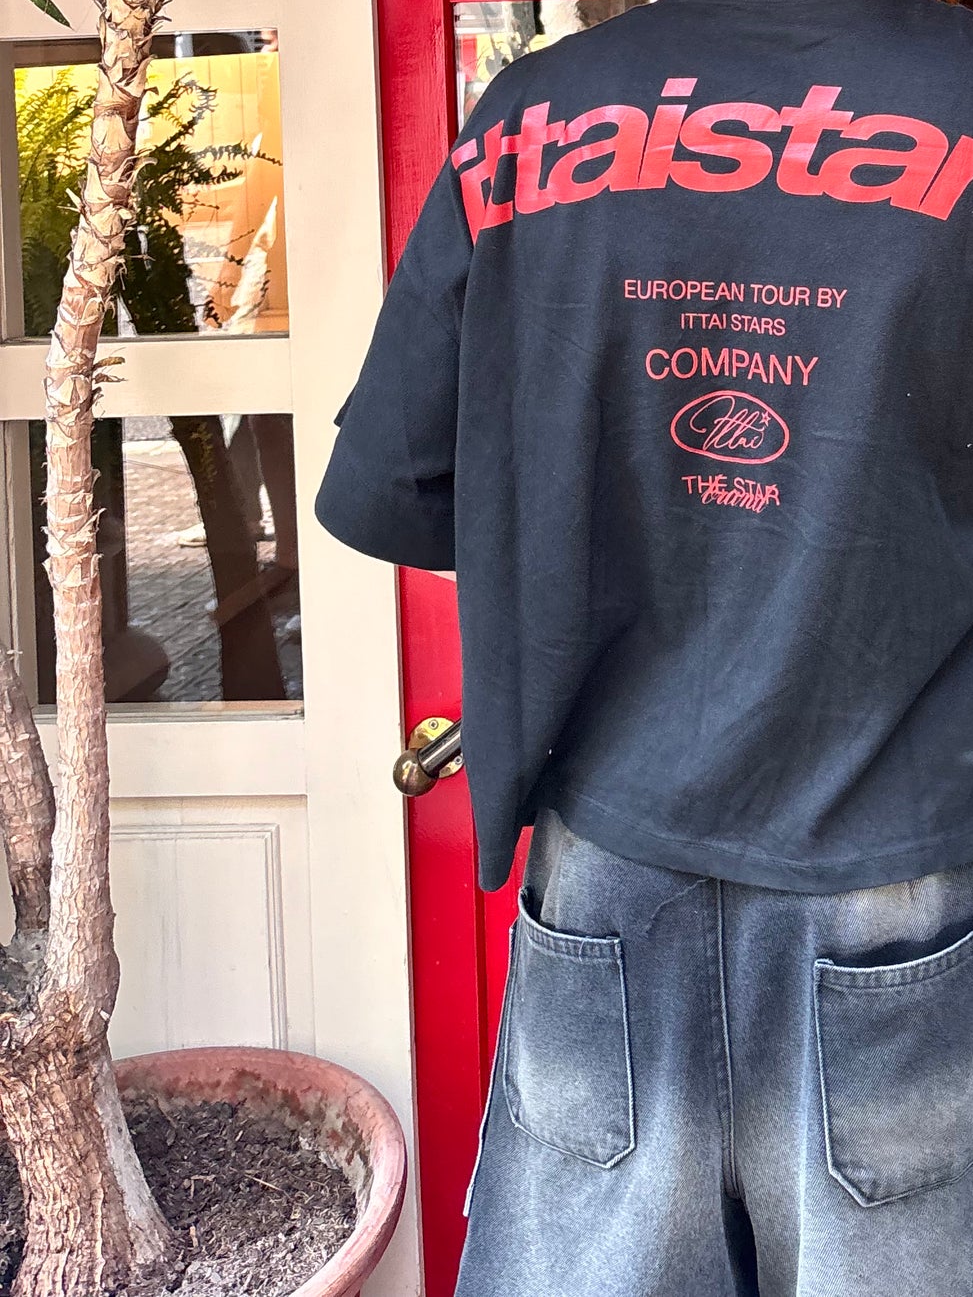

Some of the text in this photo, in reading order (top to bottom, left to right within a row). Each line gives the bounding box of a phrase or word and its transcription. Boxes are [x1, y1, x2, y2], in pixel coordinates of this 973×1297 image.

[624, 279, 848, 309] EUROPEAN TOUR BY
[680, 313, 787, 337] ITTAI STARS
[645, 347, 819, 386] COMPANY
[681, 475, 781, 506] THE STAR
